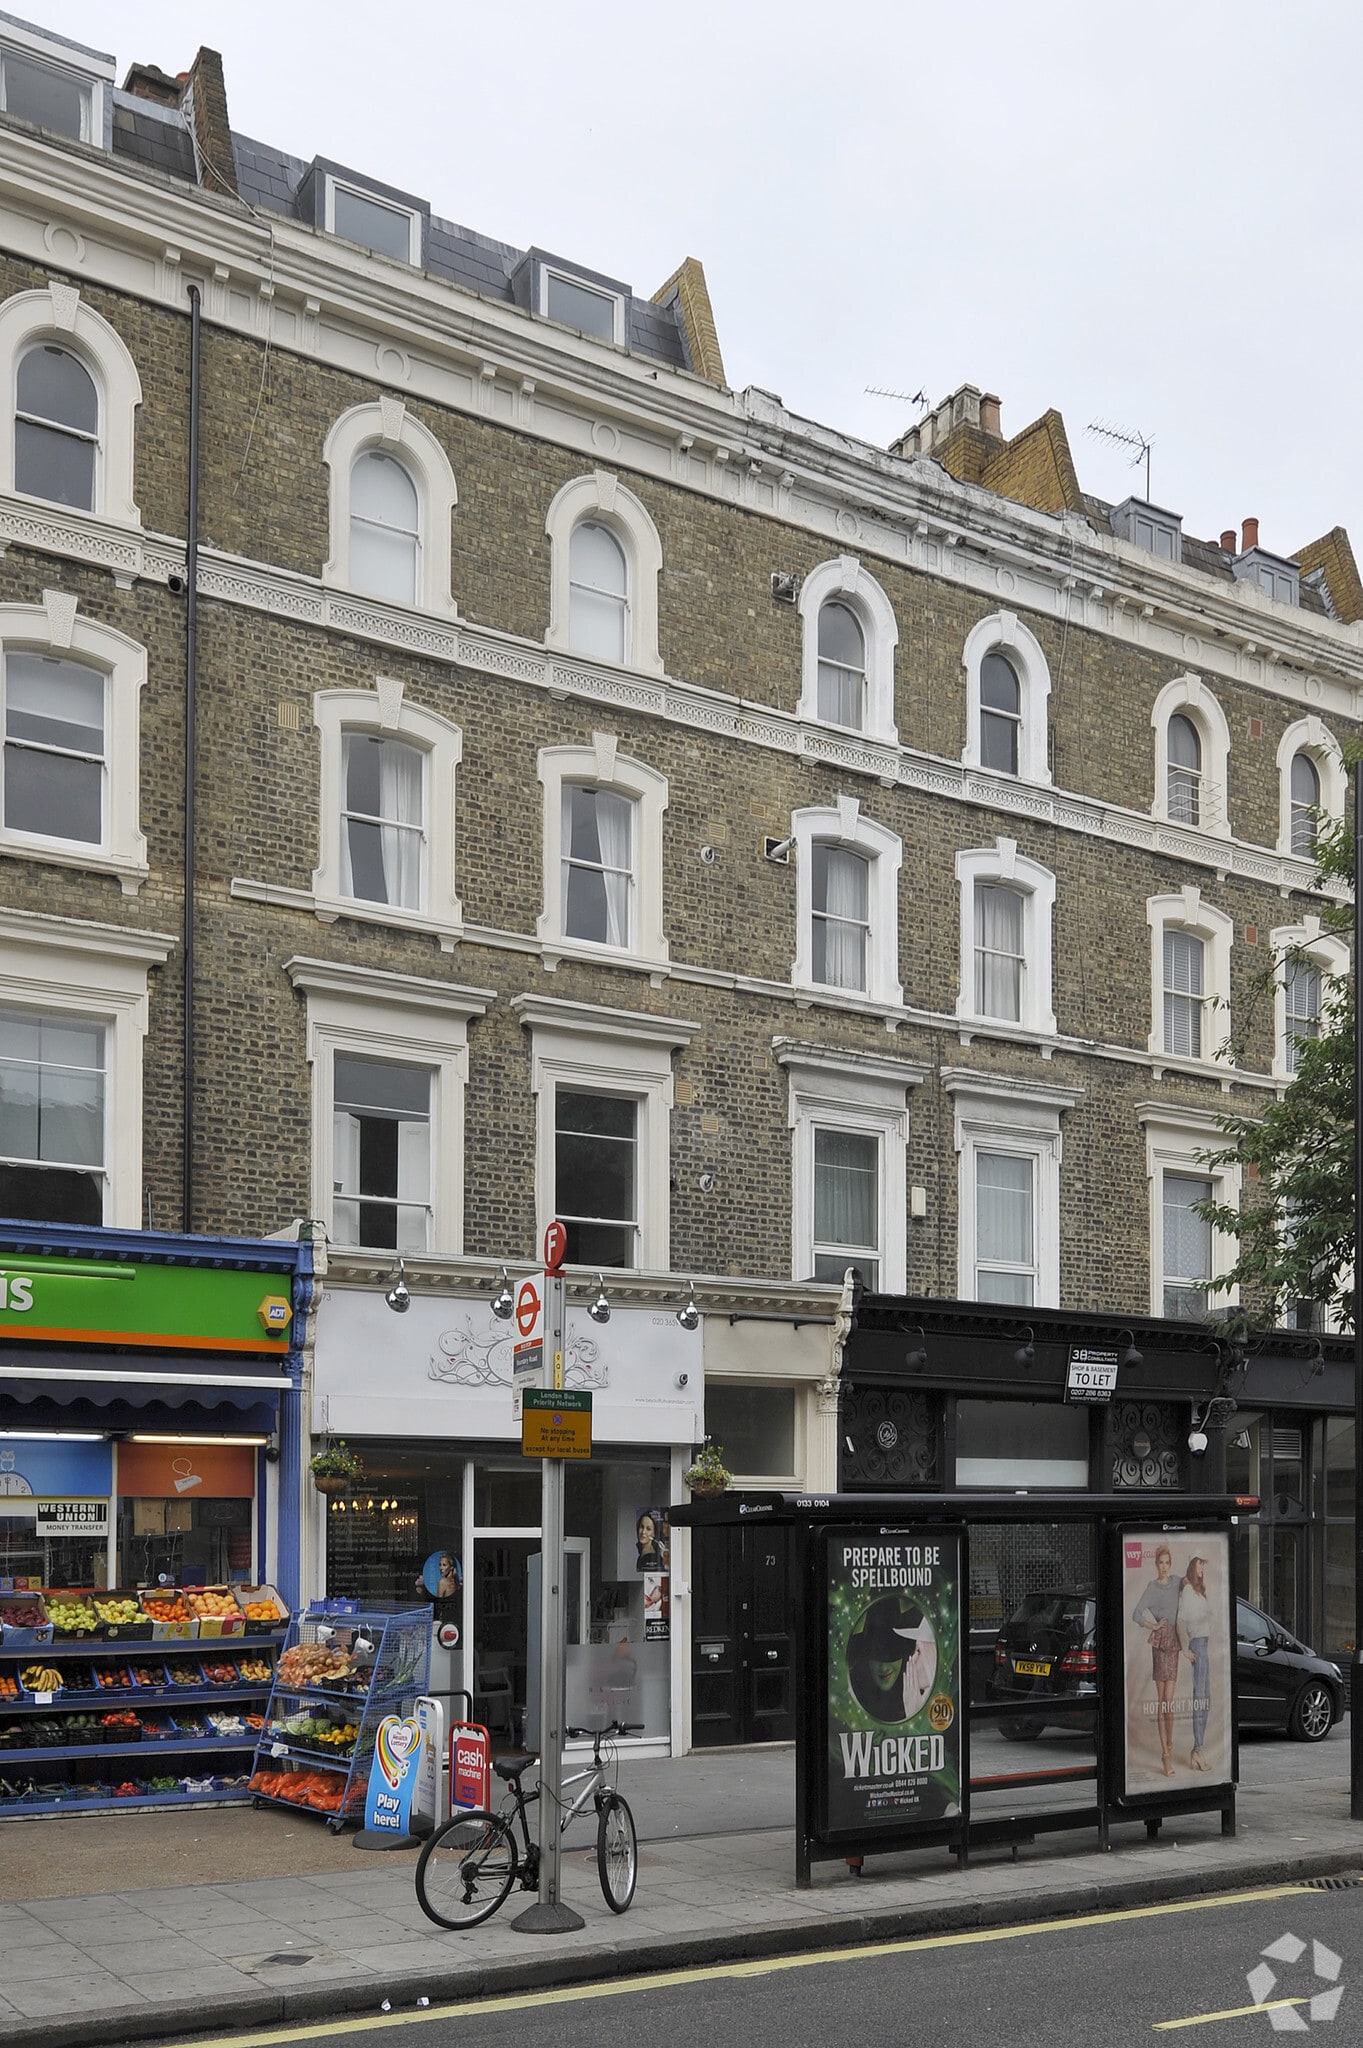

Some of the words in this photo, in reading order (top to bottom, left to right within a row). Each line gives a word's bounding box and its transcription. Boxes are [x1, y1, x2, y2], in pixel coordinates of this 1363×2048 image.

[548, 1228, 557, 1262] F
[322, 1293, 331, 1301] 73
[270, 1307, 285, 1318] ADT
[1075, 1373, 1090, 1385] TO
[1093, 1374, 1111, 1385] LET
[533, 1399, 555, 1407] Priority
[39, 1504, 95, 1513] WESTERN
[56, 1512, 95, 1521] UNION
[766, 1555, 776, 1565] 73
[843, 1547, 901, 1566] PREPARE
[905, 1547, 921, 1565] TO
[925, 1546, 940, 1565] BE
[852, 1567, 932, 1588] SPELLBOUND
[646, 1625, 670, 1633] REDKEN
[933, 1703, 948, 1719] 90
[1143, 1702, 1158, 1714] HOT
[1161, 1700, 1185, 1713] RIGHT
[1188, 1698, 1210, 1711] NOW!
[391, 1739, 408, 1748] Lottery
[457, 1747, 483, 1768] cash
[458, 1767, 482, 1780] machine
[377, 1793, 400, 1812] Play
[373, 1811, 399, 1828] here!
